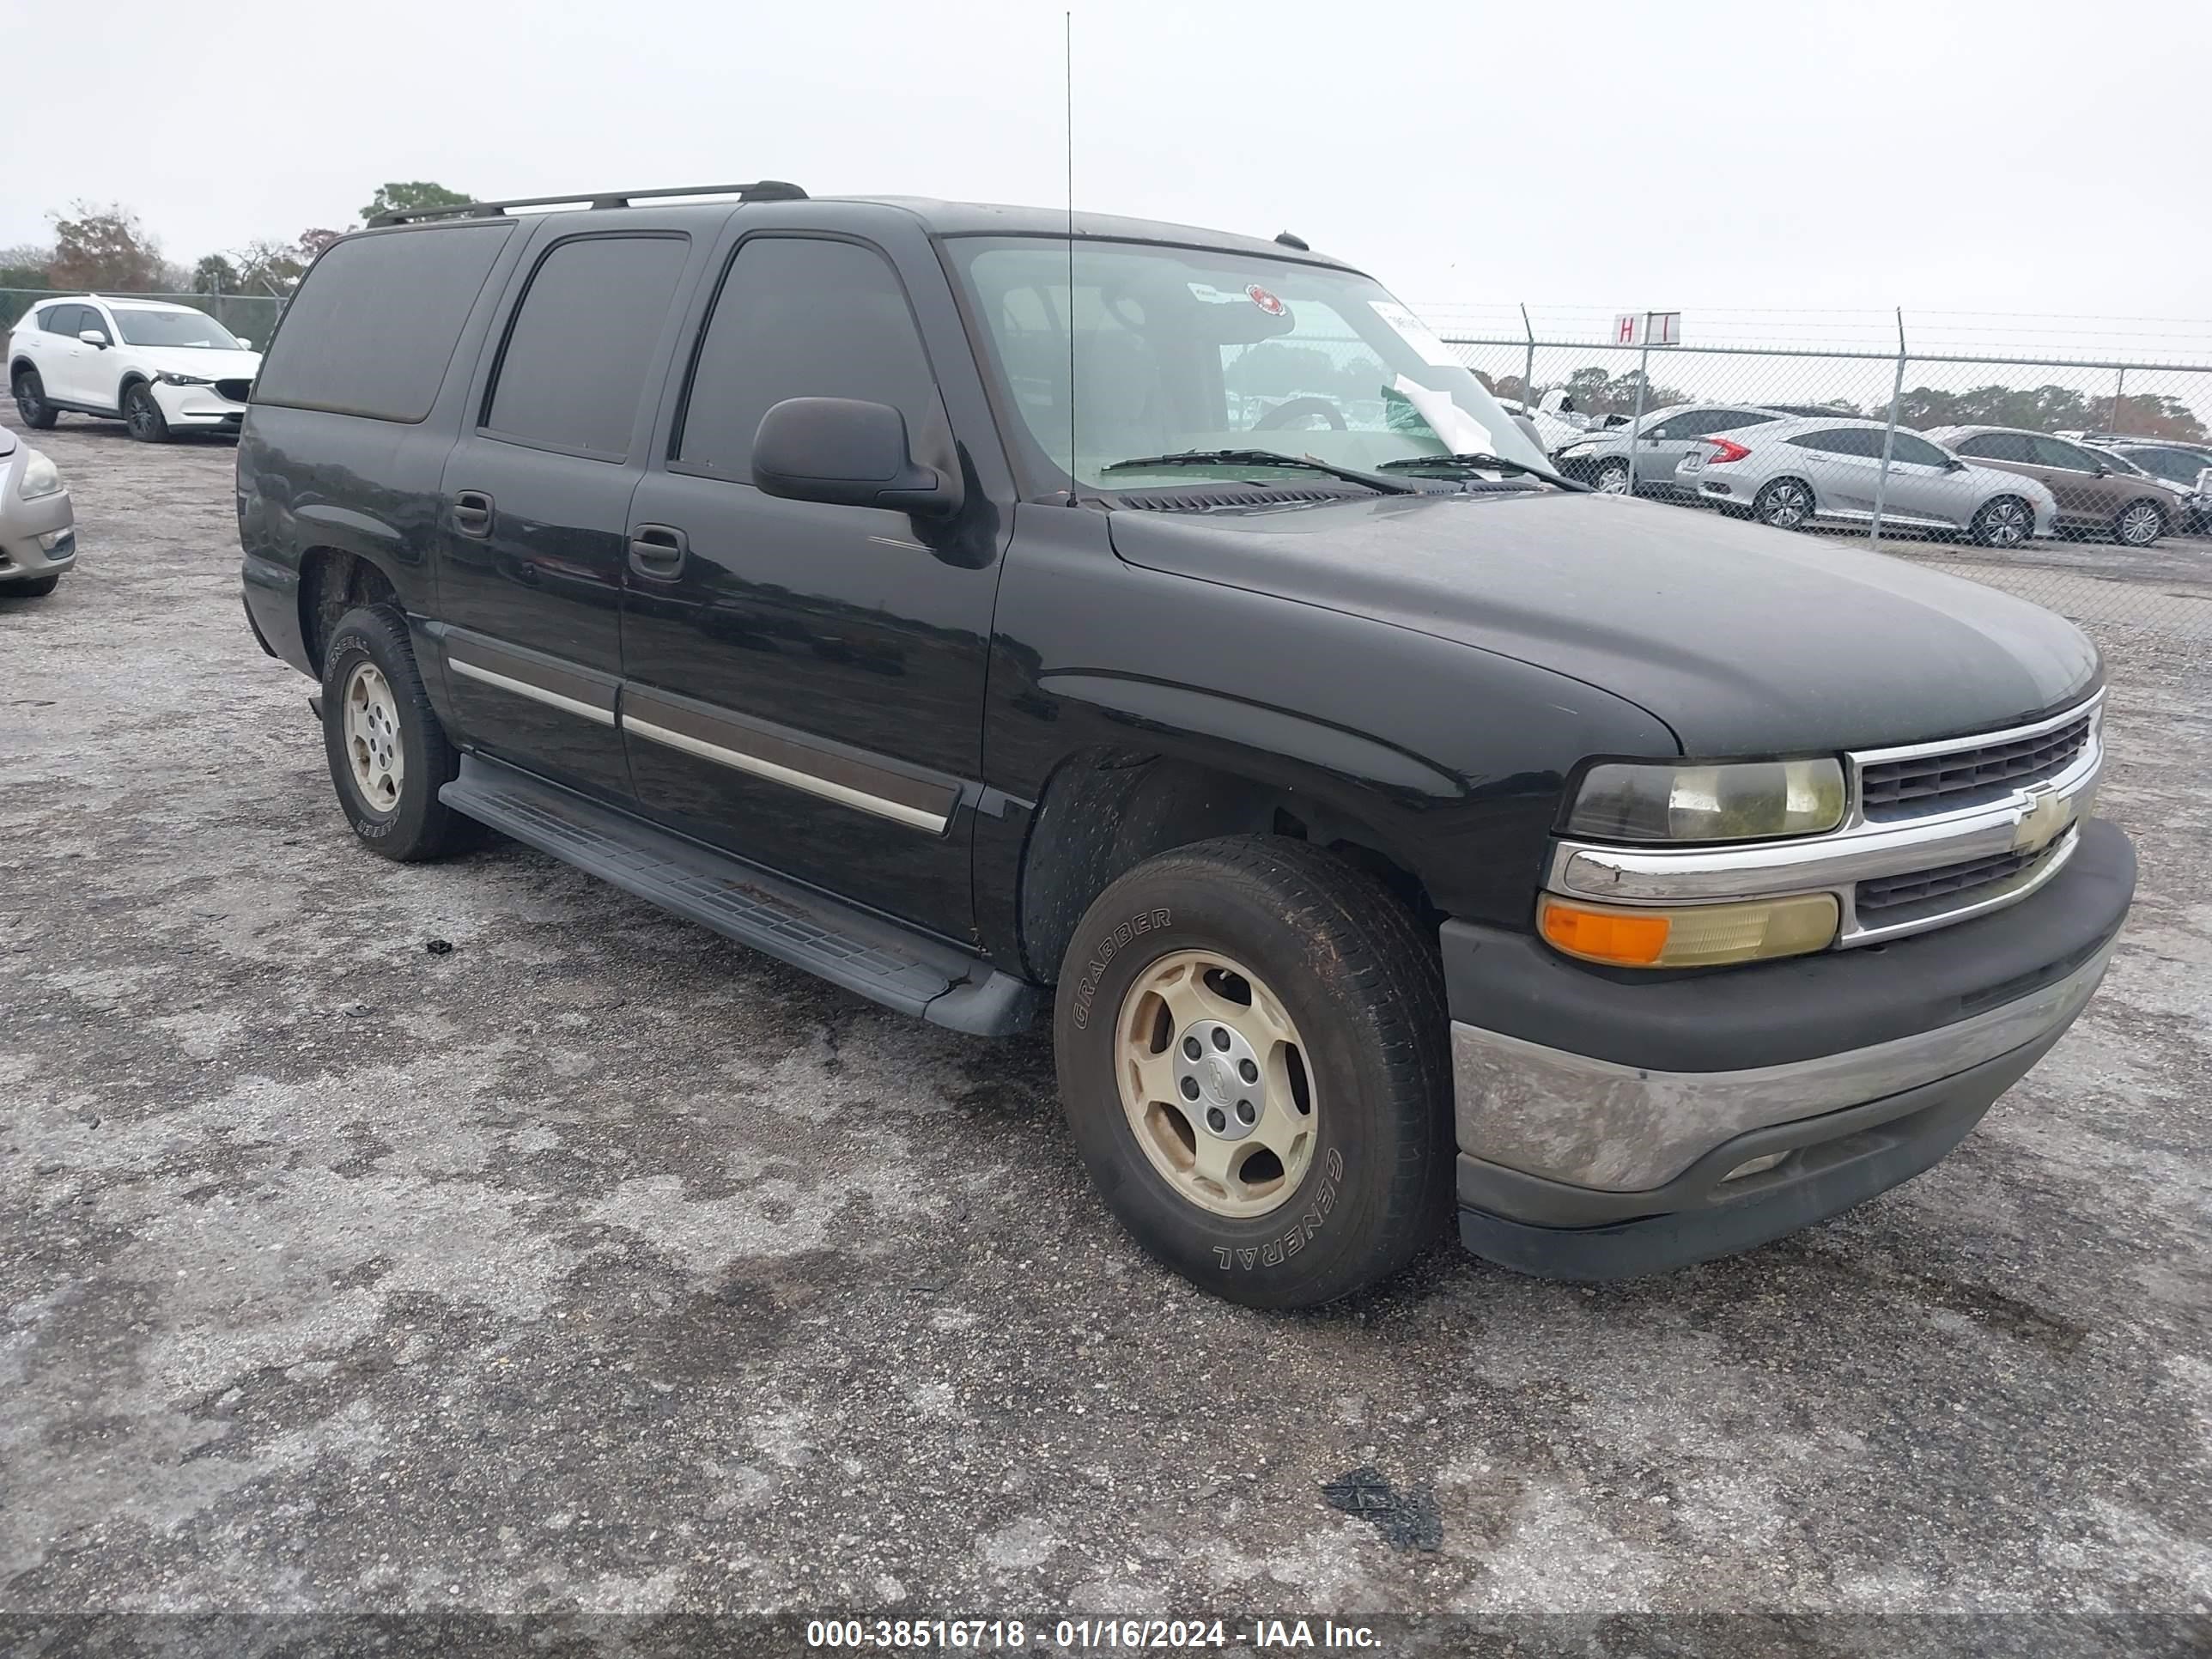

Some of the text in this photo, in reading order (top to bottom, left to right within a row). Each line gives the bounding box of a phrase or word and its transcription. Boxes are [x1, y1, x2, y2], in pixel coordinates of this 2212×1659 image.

[1620, 317, 1634, 343] H
[1073, 908, 1171, 1030] GRABBER
[1212, 1147, 1344, 1271] GENERAL
